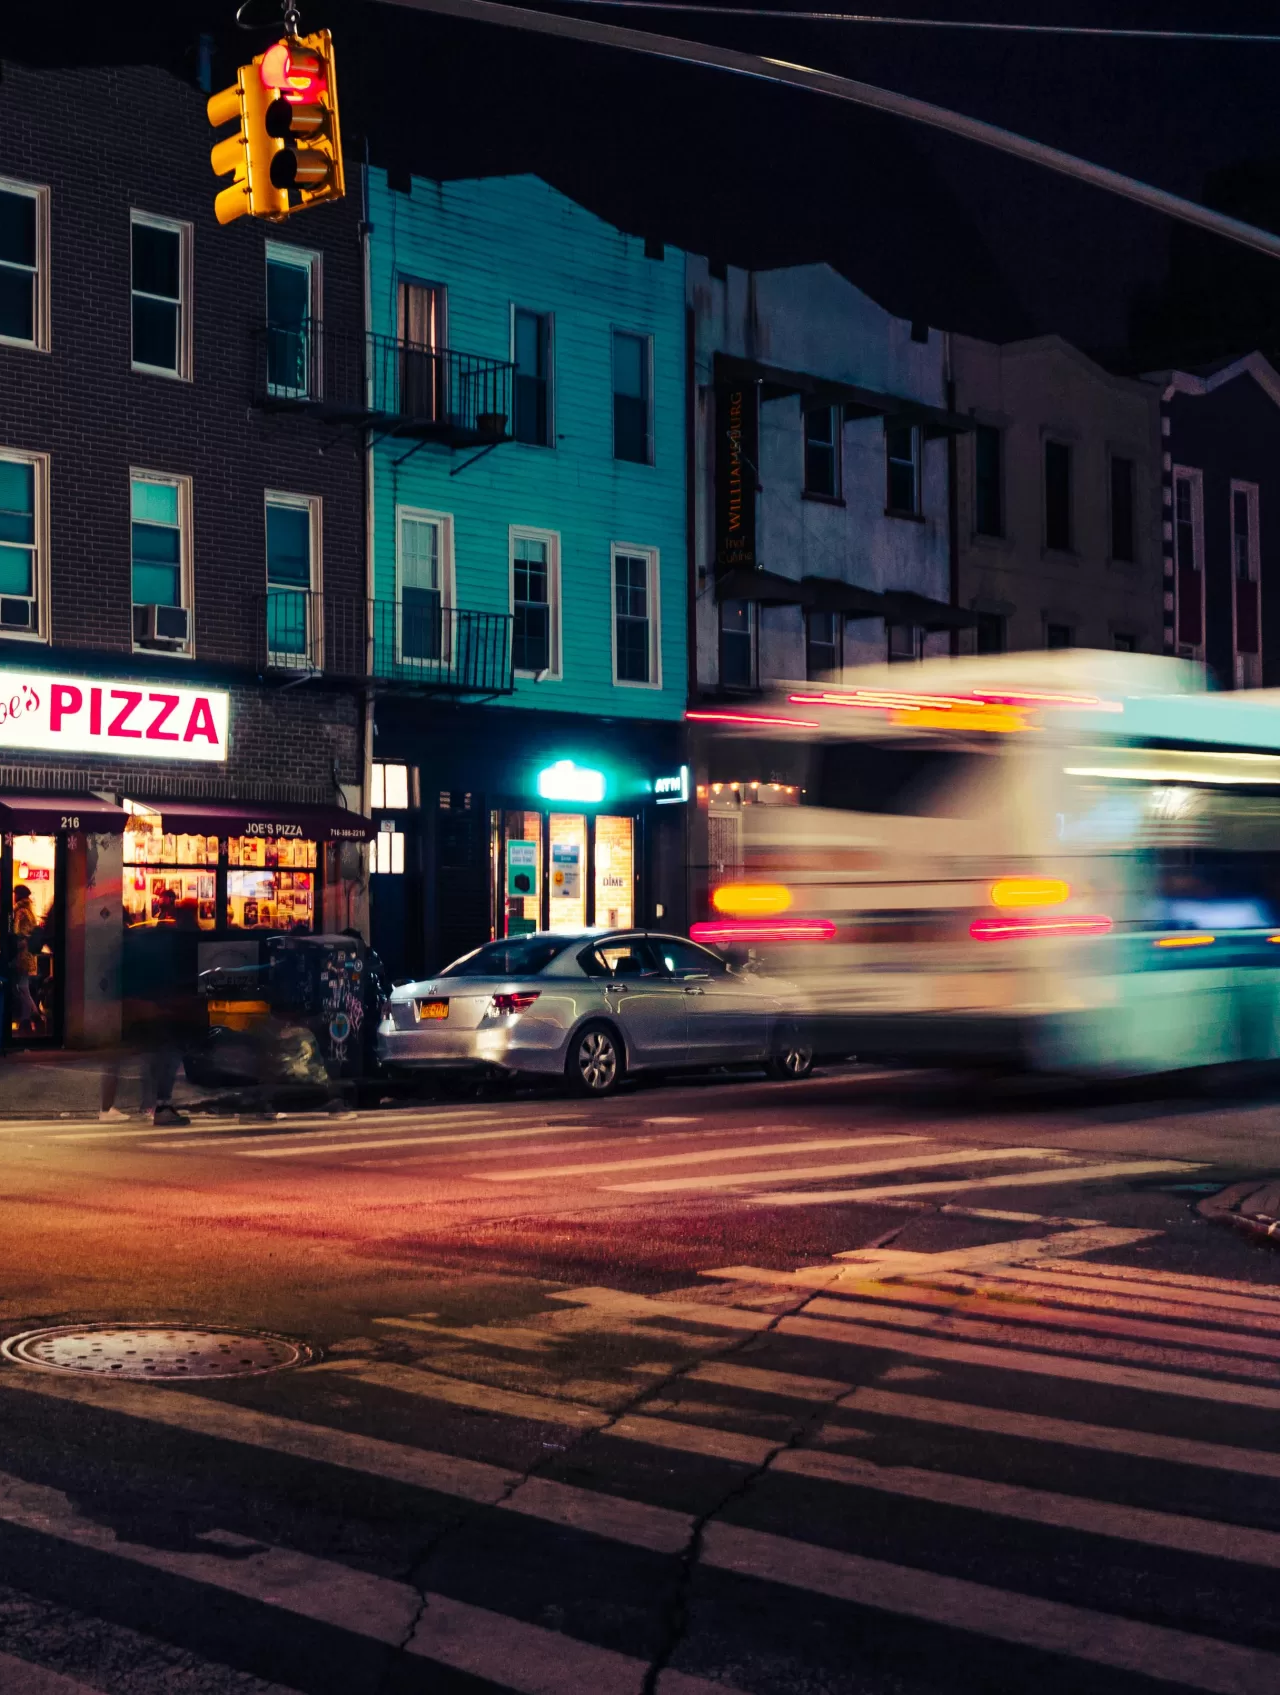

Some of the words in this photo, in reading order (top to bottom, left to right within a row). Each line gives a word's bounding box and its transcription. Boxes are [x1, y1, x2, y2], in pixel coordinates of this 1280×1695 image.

[50, 684, 219, 744] PIZZA
[655, 777, 680, 793] ATM
[61, 816, 80, 829] 216
[245, 823, 274, 835] JOE'S
[276, 824, 303, 836] PIZZA
